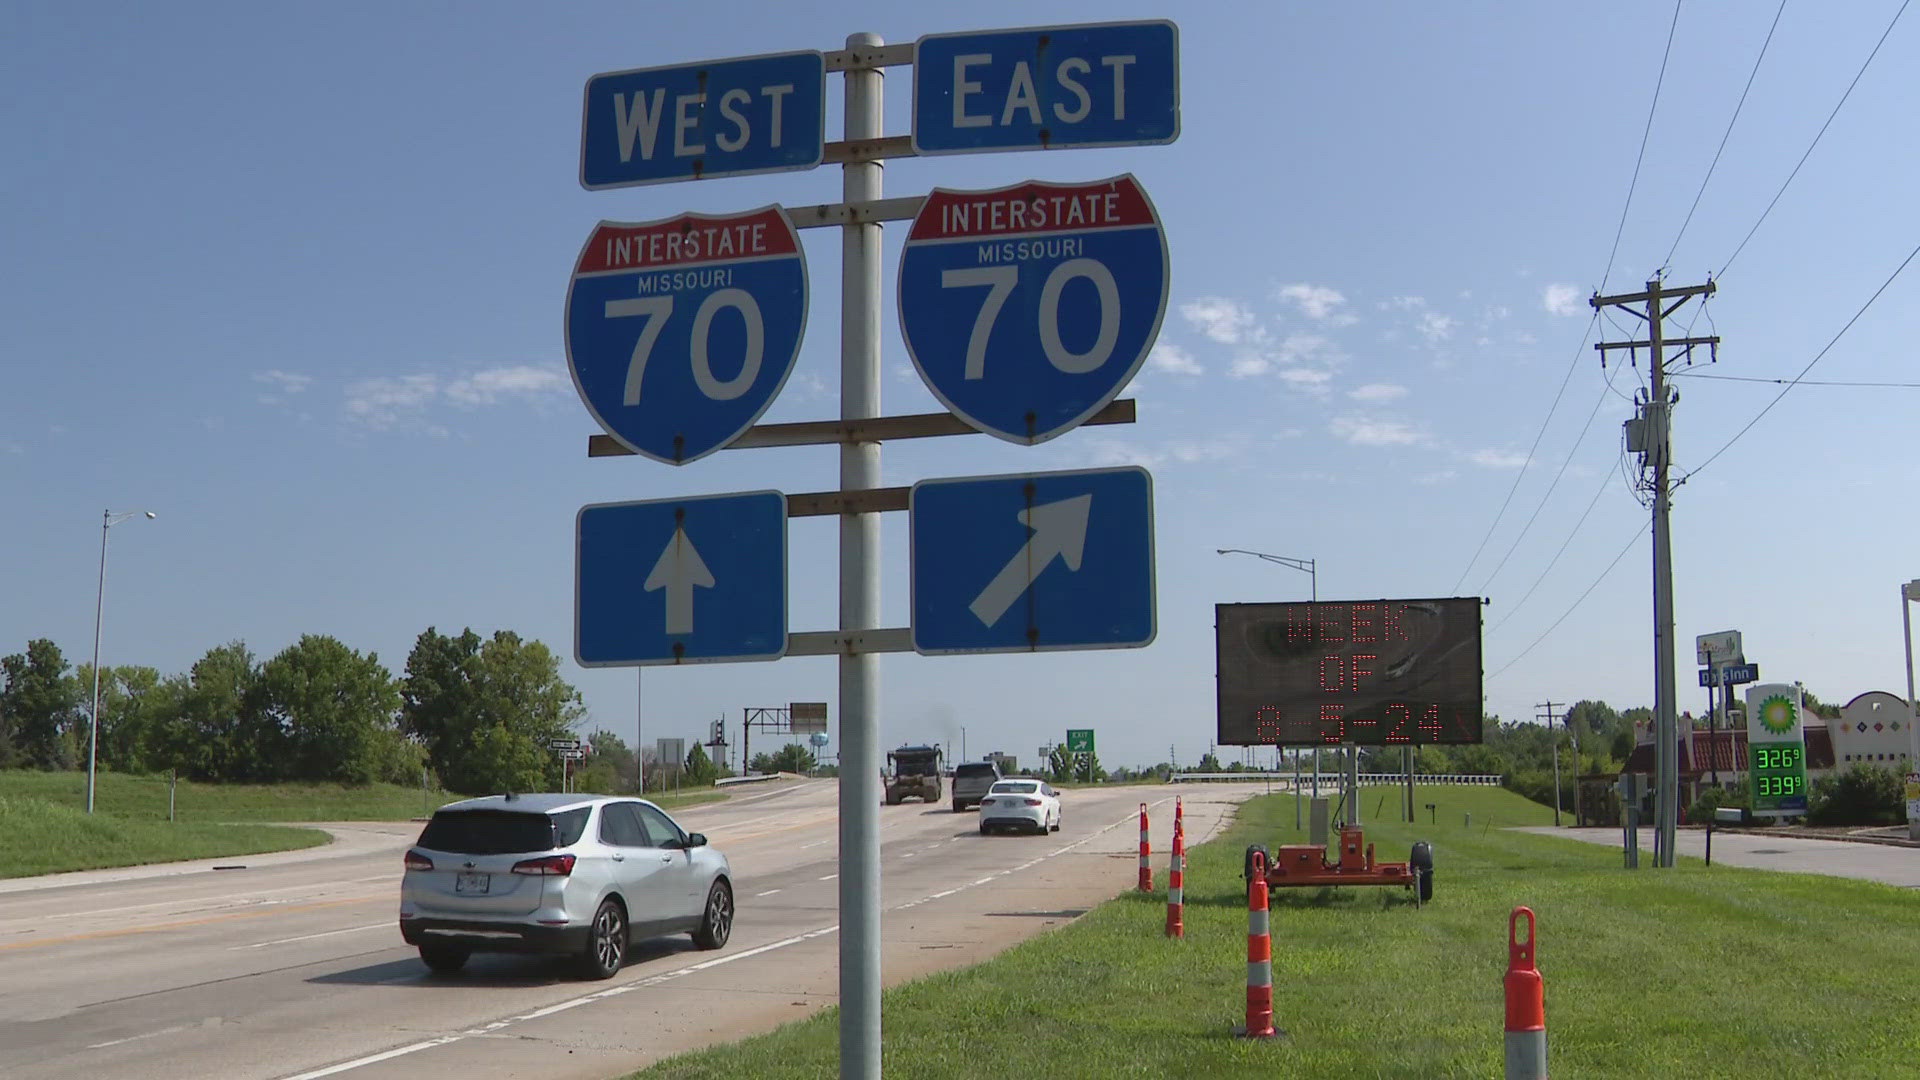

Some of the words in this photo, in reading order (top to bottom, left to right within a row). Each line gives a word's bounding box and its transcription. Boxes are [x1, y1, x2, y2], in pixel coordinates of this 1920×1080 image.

[952, 53, 1137, 129] EAST
[612, 83, 794, 164] WEST
[941, 192, 1121, 234] INTERSTATE
[606, 223, 768, 267] INTERSTATE
[977, 237, 1084, 264] MISSOURI
[637, 268, 733, 295] MISSOURI
[941, 257, 1122, 381] 70
[604, 287, 765, 407] 70
[1287, 604, 1409, 643] WEEK
[1319, 653, 1377, 692] OF
[1730, 668, 1750, 681] Inn
[1071, 731, 1088, 739] EXIT
[1256, 703, 1444, 743] 8-5-24
